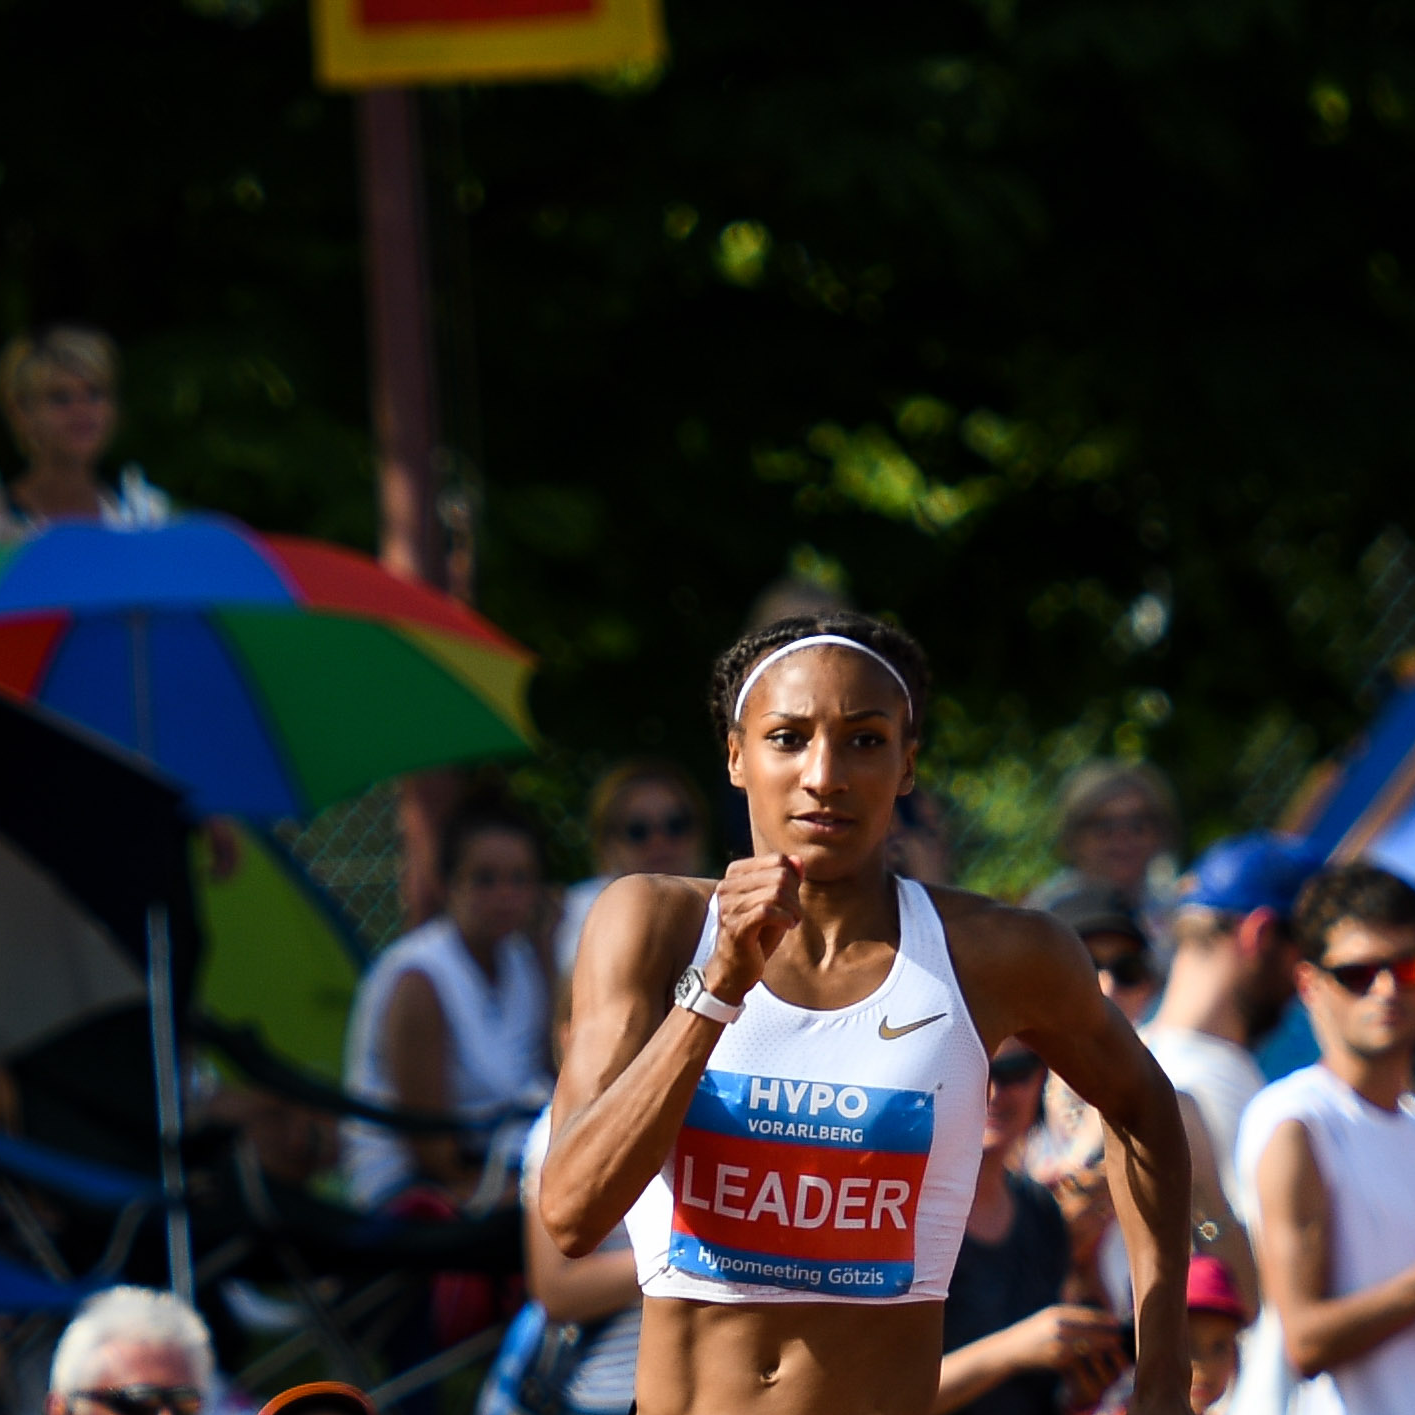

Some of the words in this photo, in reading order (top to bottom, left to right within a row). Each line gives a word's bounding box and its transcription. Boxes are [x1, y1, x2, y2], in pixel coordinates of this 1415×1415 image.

[748, 1077, 868, 1119] HYPO
[748, 1119, 864, 1143] VORARLBERG
[681, 1155, 911, 1230] LEADER
[697, 1246, 822, 1286] Hypomeeting
[828, 1267, 885, 1286] Götzis
